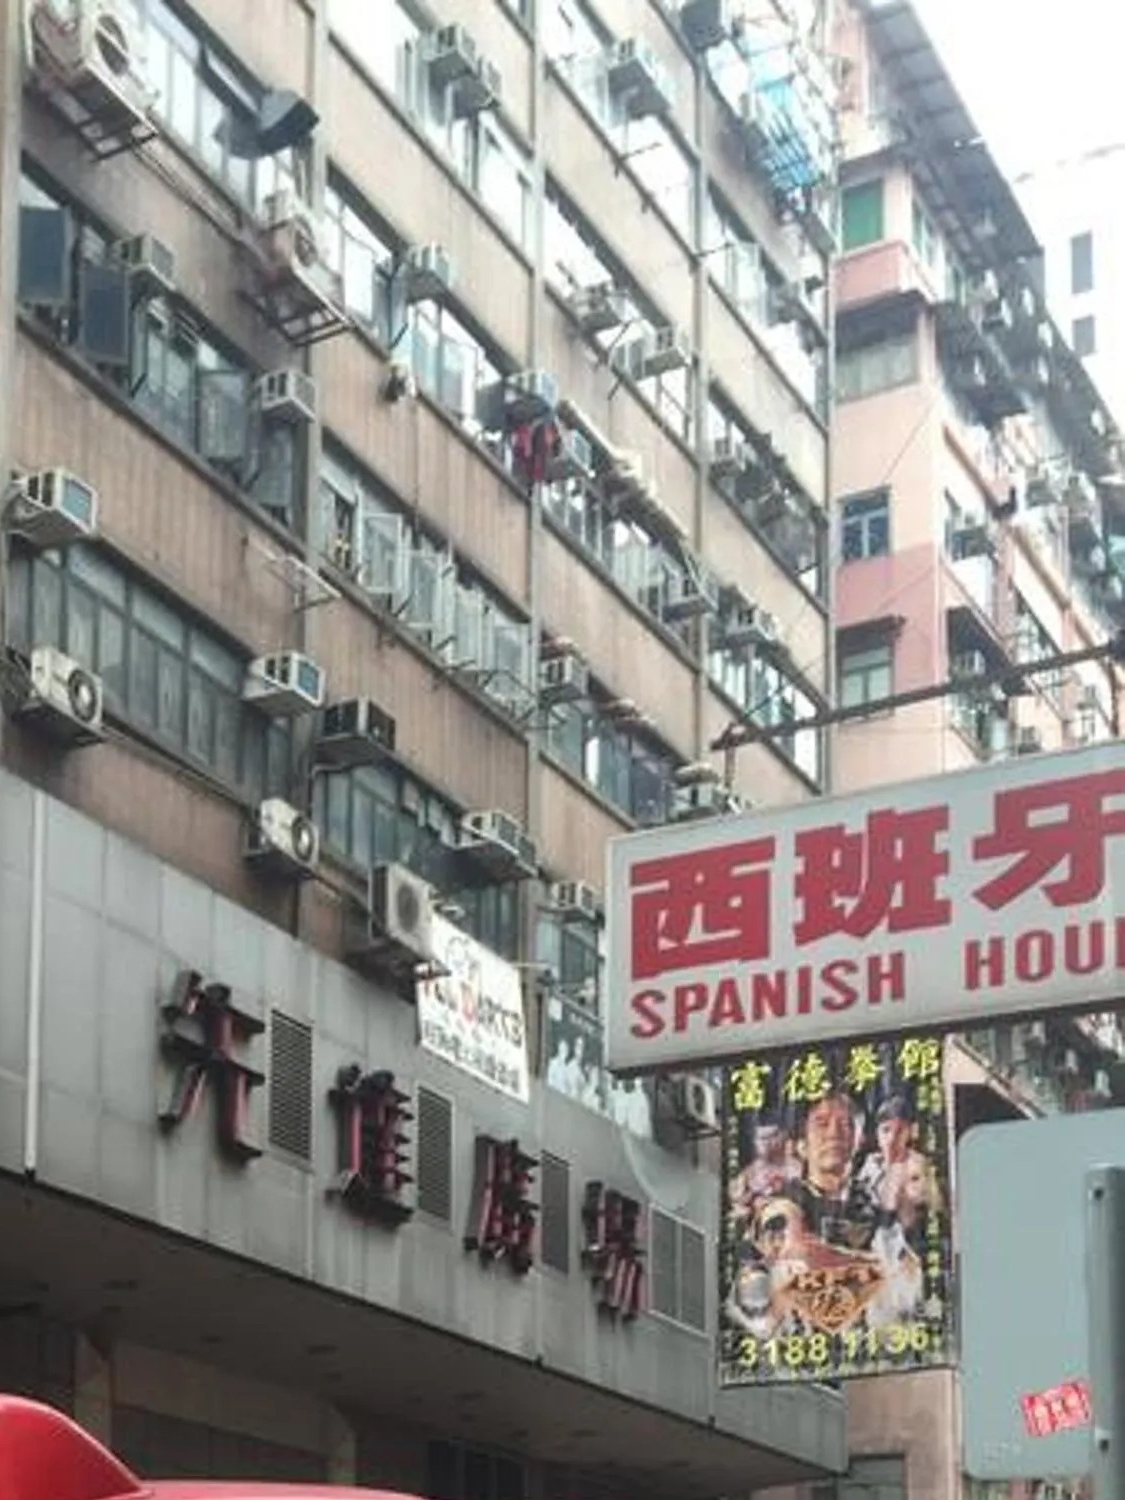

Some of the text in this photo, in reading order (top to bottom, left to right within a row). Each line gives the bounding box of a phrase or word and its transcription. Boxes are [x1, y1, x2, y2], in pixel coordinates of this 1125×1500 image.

[631, 768, 1125, 980] 西班牙
[631, 951, 906, 1040] SPANISH
[739, 1333, 828, 1367] 3188
